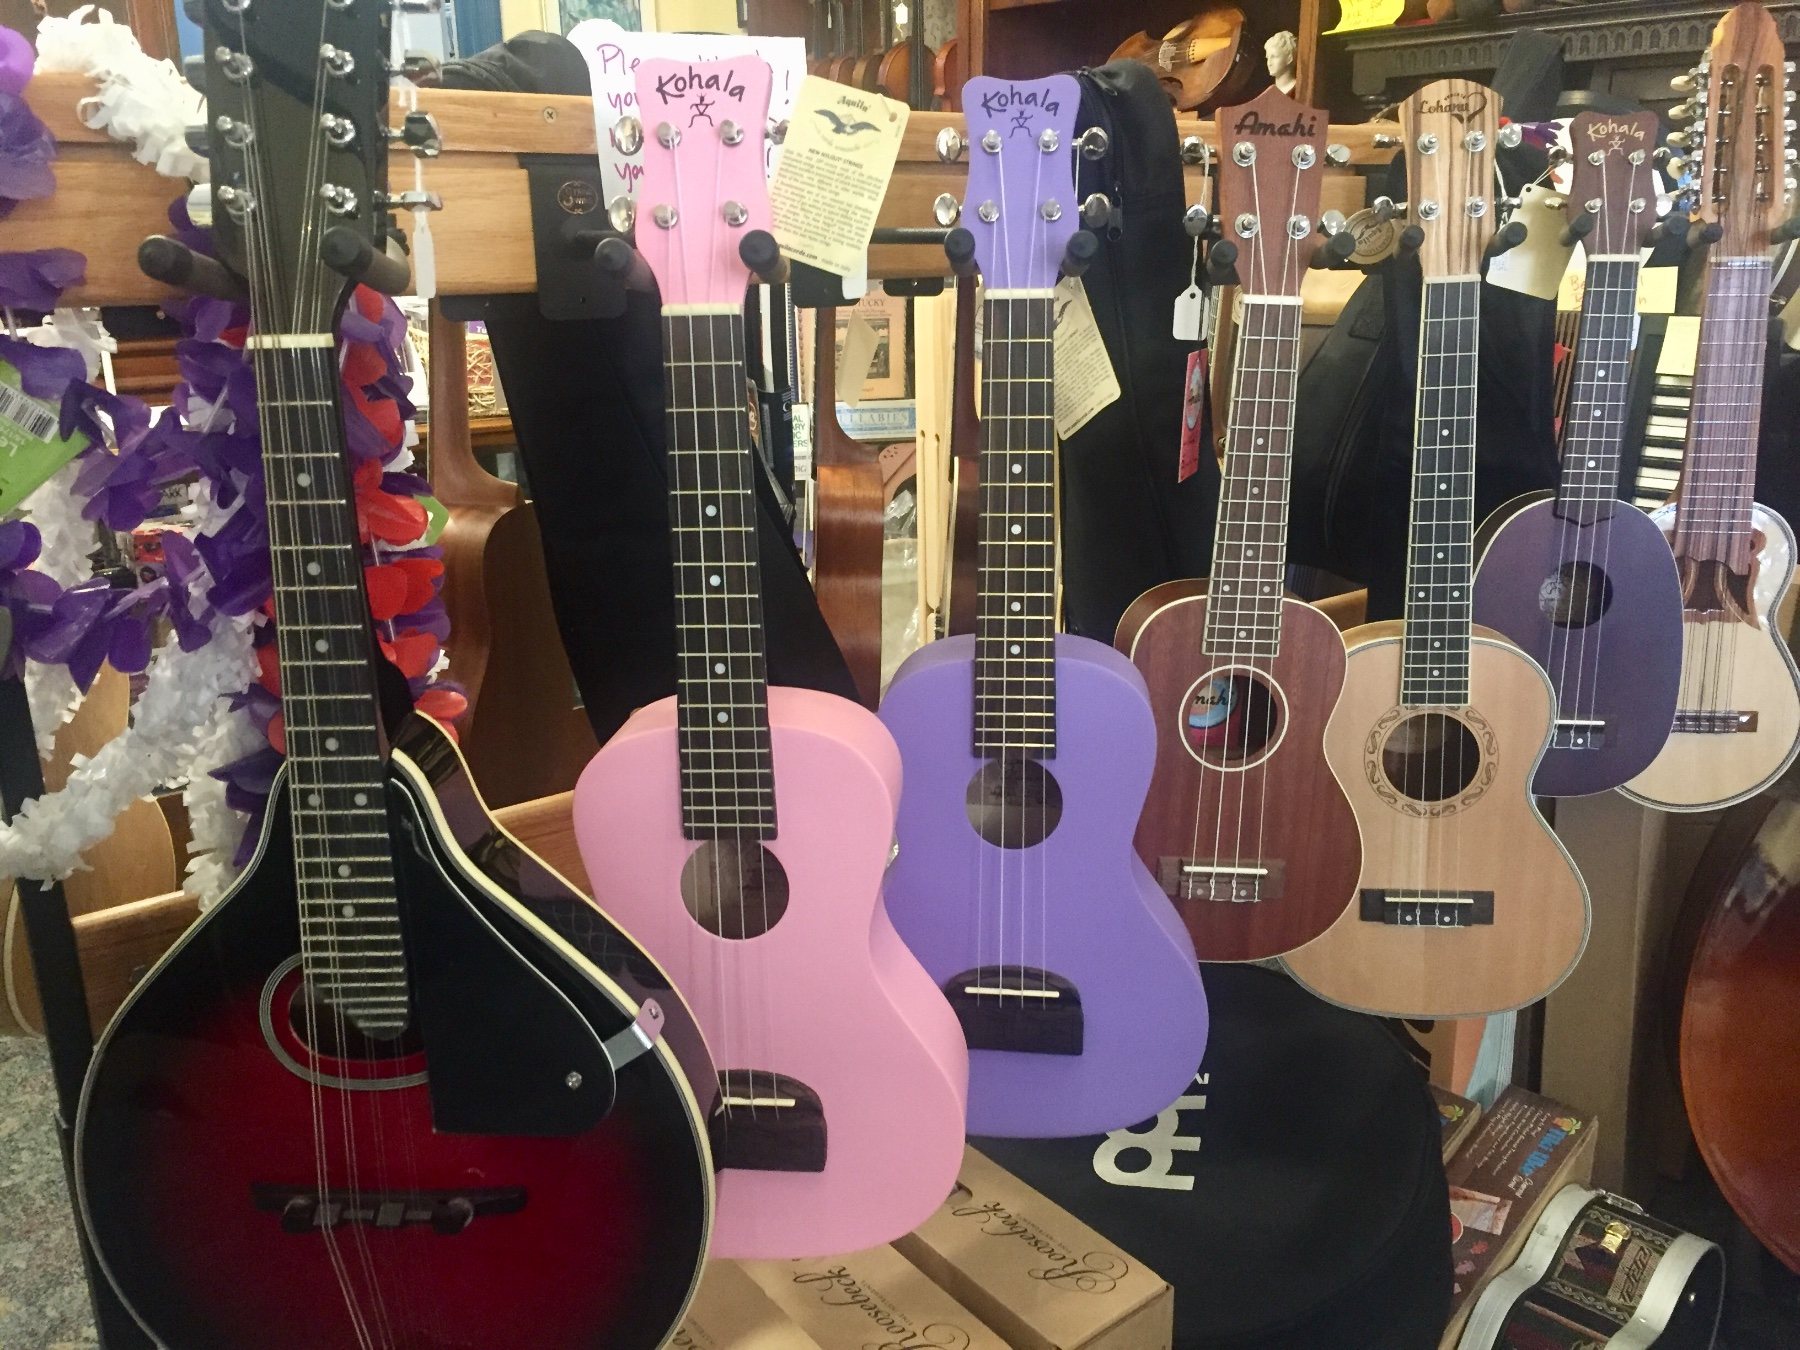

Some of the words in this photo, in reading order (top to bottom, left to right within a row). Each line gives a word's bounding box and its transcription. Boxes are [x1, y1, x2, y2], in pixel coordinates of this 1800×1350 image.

[597, 43, 641, 75] Ple
[656, 65, 746, 105] Kohala
[981, 84, 1060, 118] Kohala
[837, 95, 870, 113] Aquila
[1233, 110, 1317, 137] Amahi
[1587, 118, 1646, 142] Kohala
[952, 1201, 1129, 1295] Roosebeck
